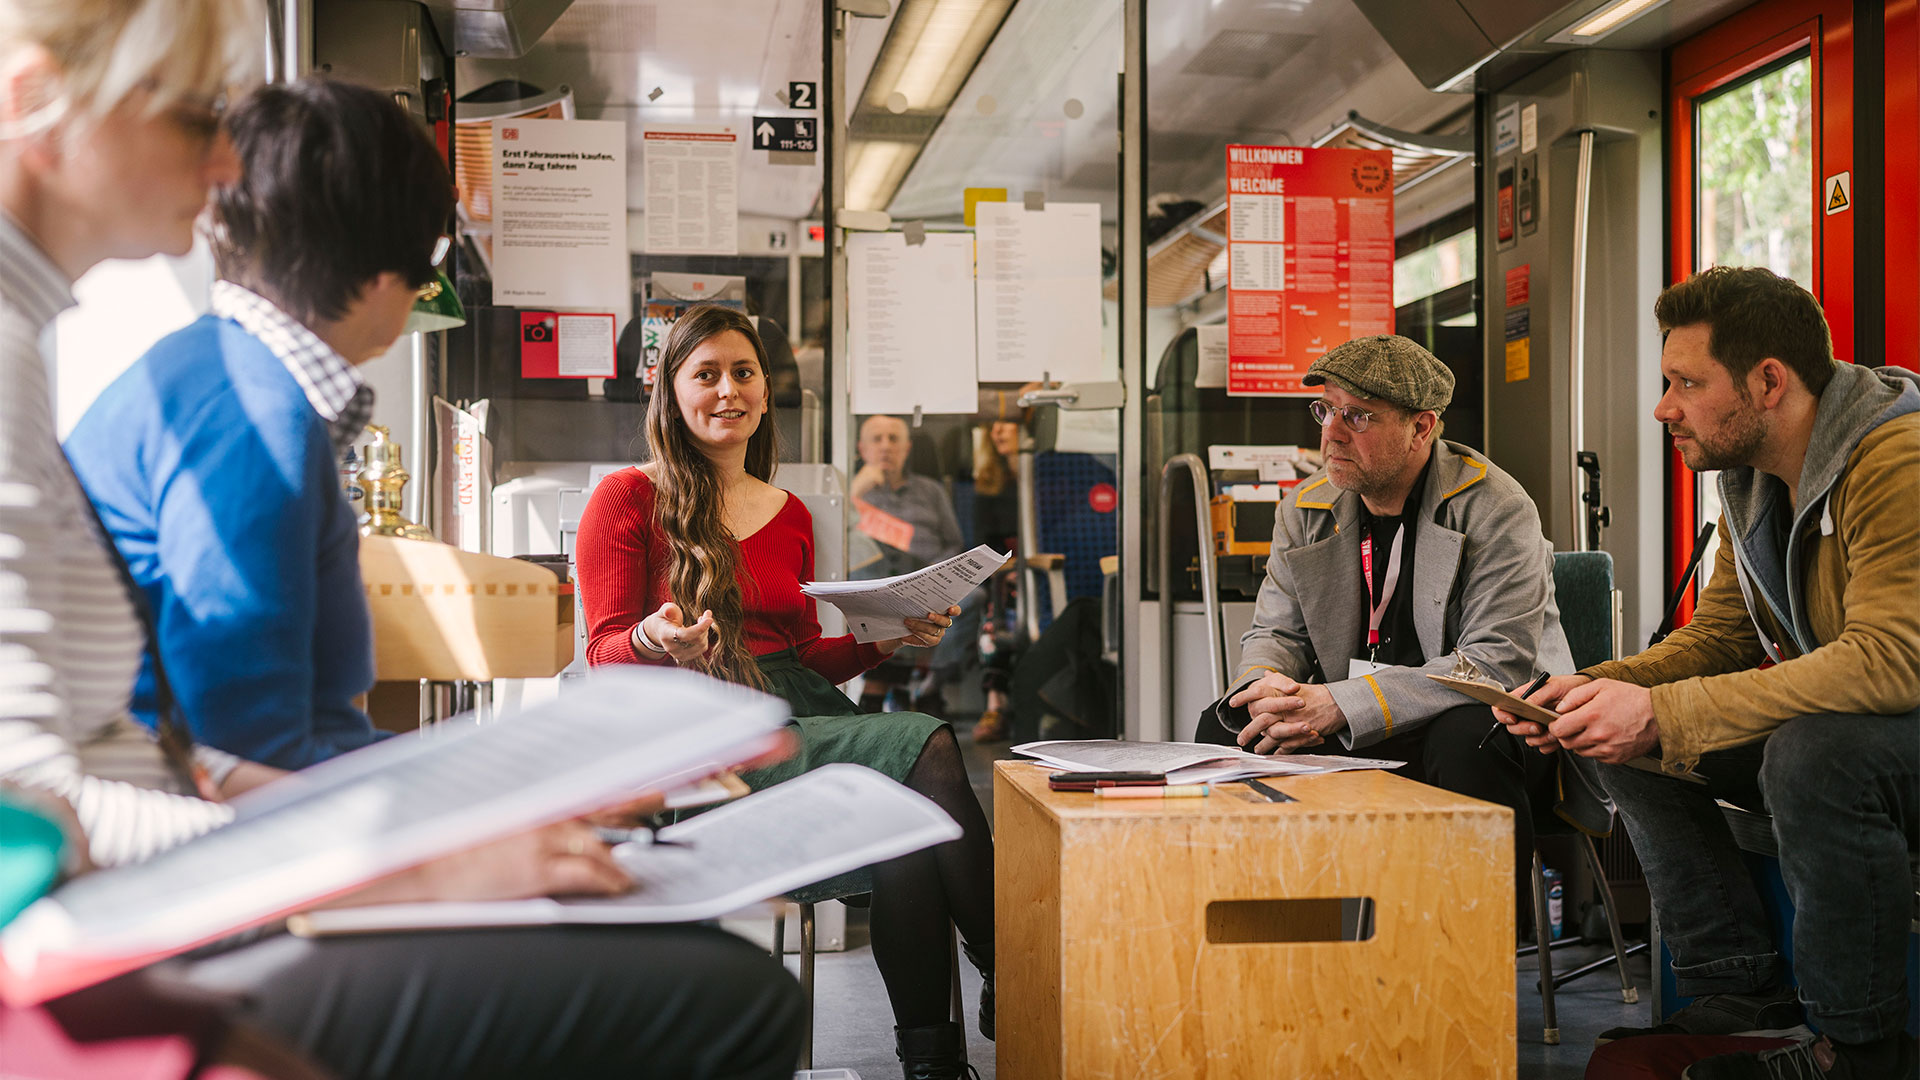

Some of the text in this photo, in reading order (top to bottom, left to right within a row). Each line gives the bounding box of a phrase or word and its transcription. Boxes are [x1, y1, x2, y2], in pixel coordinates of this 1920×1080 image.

[795, 84, 811, 107] 2
[780, 140, 814, 149] 111-126
[502, 150, 615, 162] Erst Fahrausweis kaufen,
[1230, 148, 1303, 165] WILLKOMMEN
[502, 161, 577, 171] dann Zug fahren
[1230, 178, 1284, 193] WELCOME
[458, 434, 473, 505] TOP END
